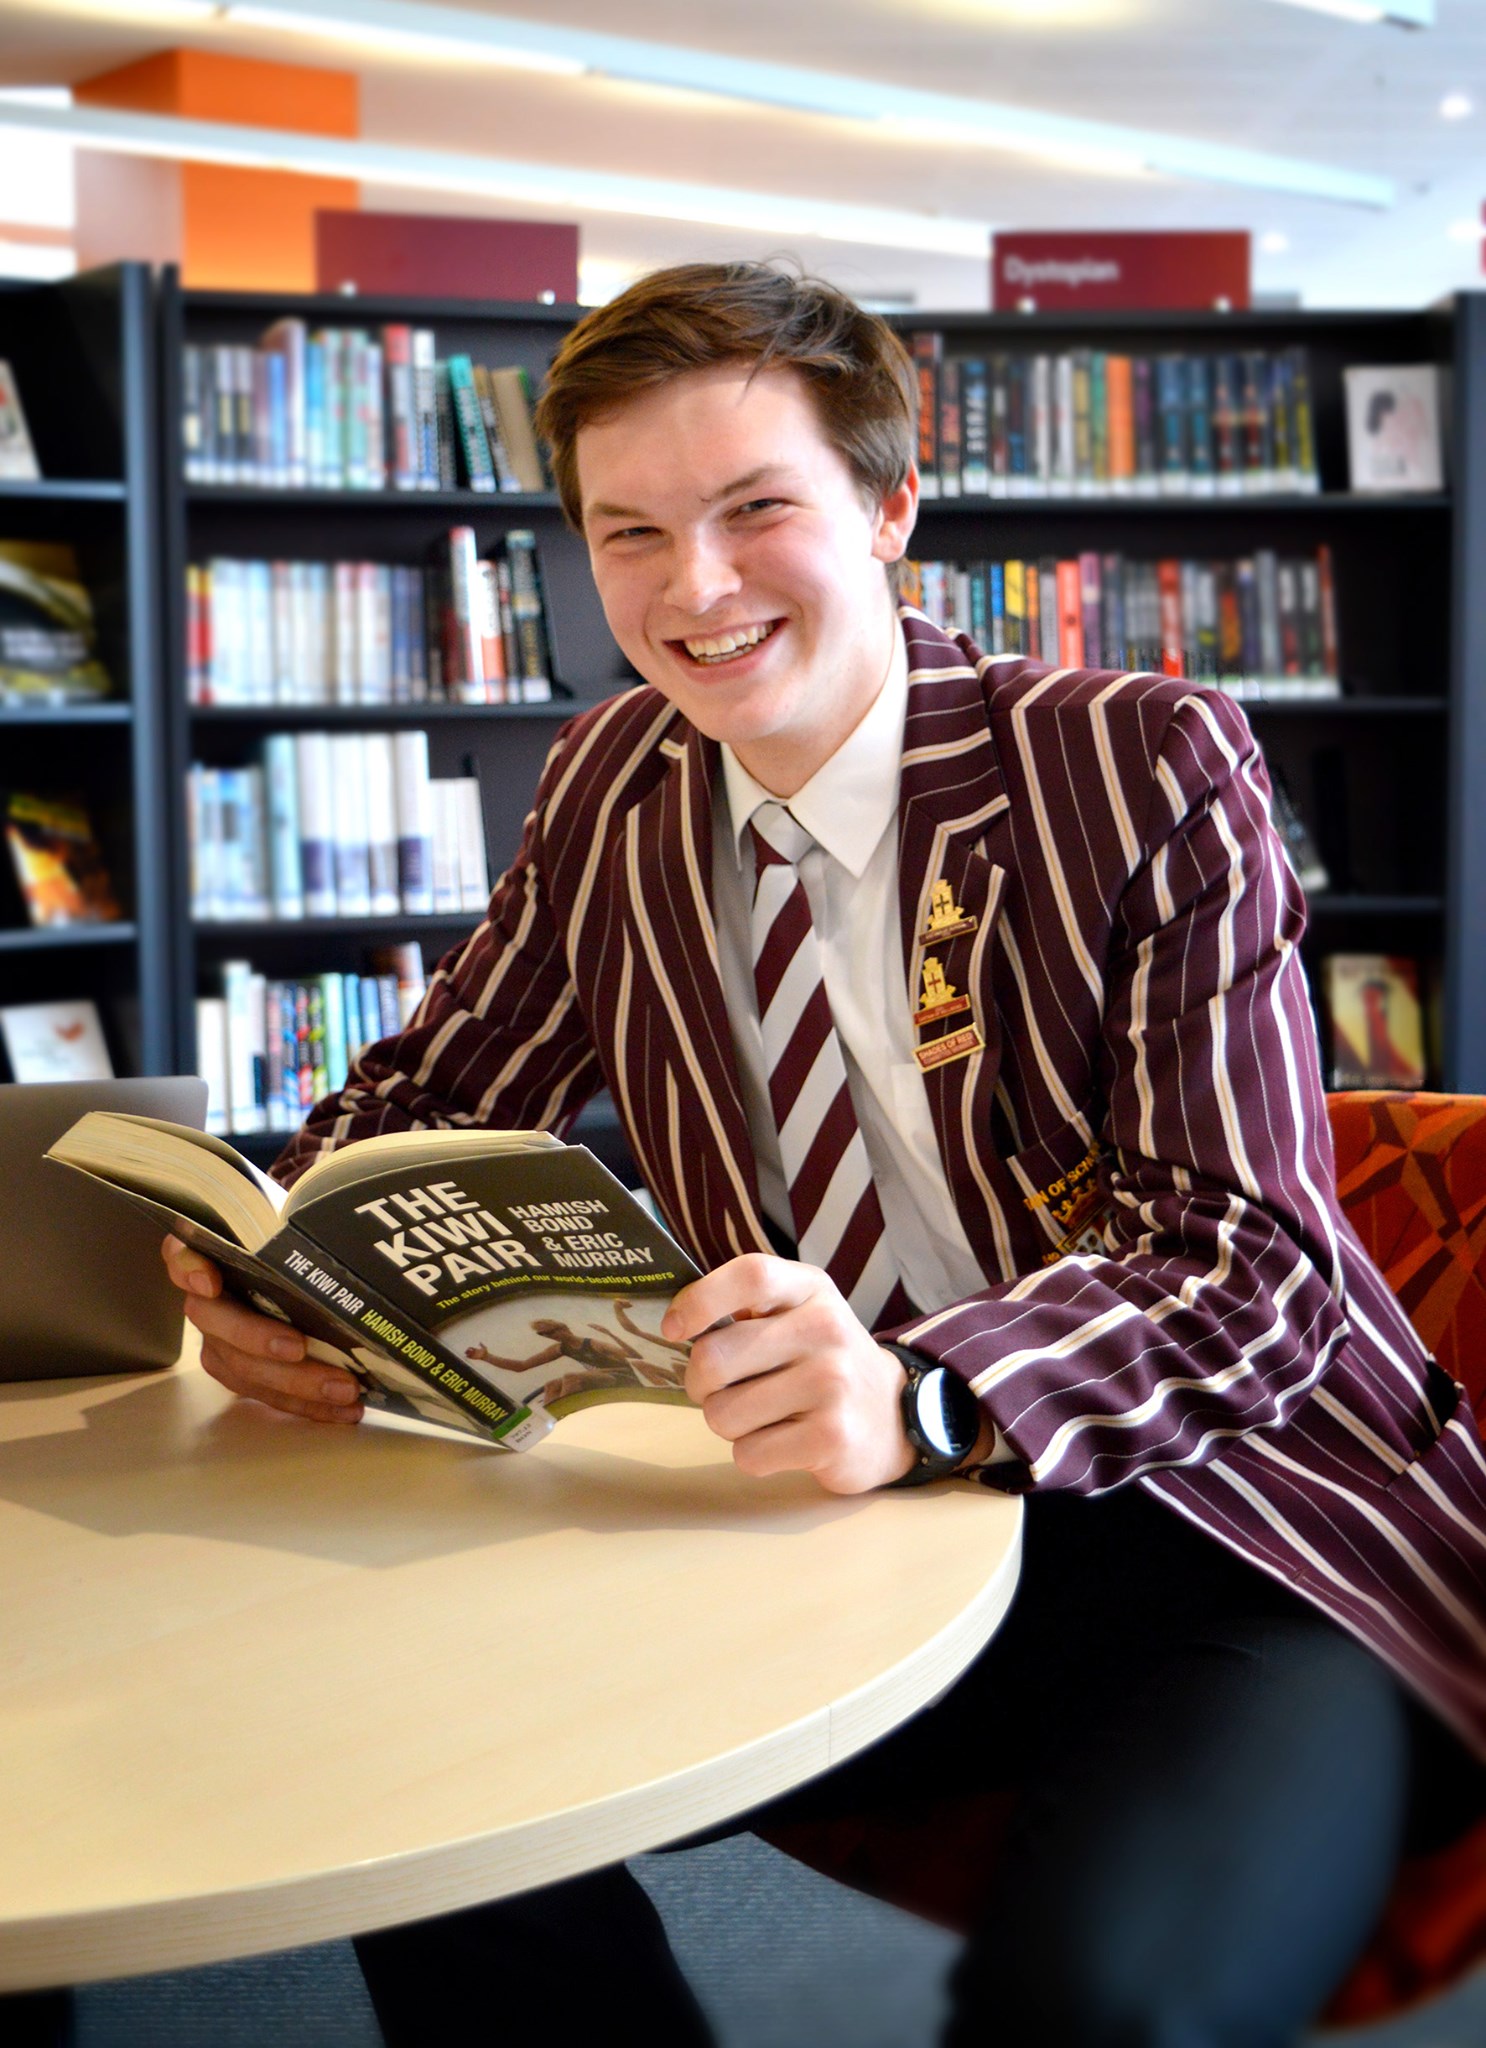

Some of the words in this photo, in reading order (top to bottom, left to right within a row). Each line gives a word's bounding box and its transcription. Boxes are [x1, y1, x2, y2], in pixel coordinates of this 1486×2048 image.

[1003, 255, 1121, 289] Dystopian
[918, 1042, 947, 1059] SHADES
[946, 1038, 957, 1048] OF
[956, 1031, 974, 1044] RED
[1047, 1178, 1067, 1197] OF
[354, 1181, 481, 1230] THE
[507, 1199, 610, 1220] HAMISH
[373, 1210, 513, 1268] KIWI
[521, 1215, 595, 1234] BOND
[541, 1236, 565, 1252] &
[564, 1232, 625, 1252] ERIC
[402, 1239, 543, 1297] PAIR
[551, 1247, 655, 1269] MURRAY
[435, 1296, 460, 1309] The
[460, 1284, 492, 1299] story
[490, 1274, 532, 1289] behind
[532, 1274, 551, 1282] our
[551, 1275, 633, 1286] world-beating
[632, 1271, 675, 1283] rowers
[283, 1250, 309, 1276] THE
[305, 1268, 336, 1296] KIWI
[331, 1290, 366, 1316] PAIR
[360, 1309, 409, 1348] HAMISH
[401, 1340, 437, 1370] BOND
[429, 1362, 446, 1378] &
[438, 1369, 470, 1394] ERIC
[462, 1386, 509, 1423] MURRAY
